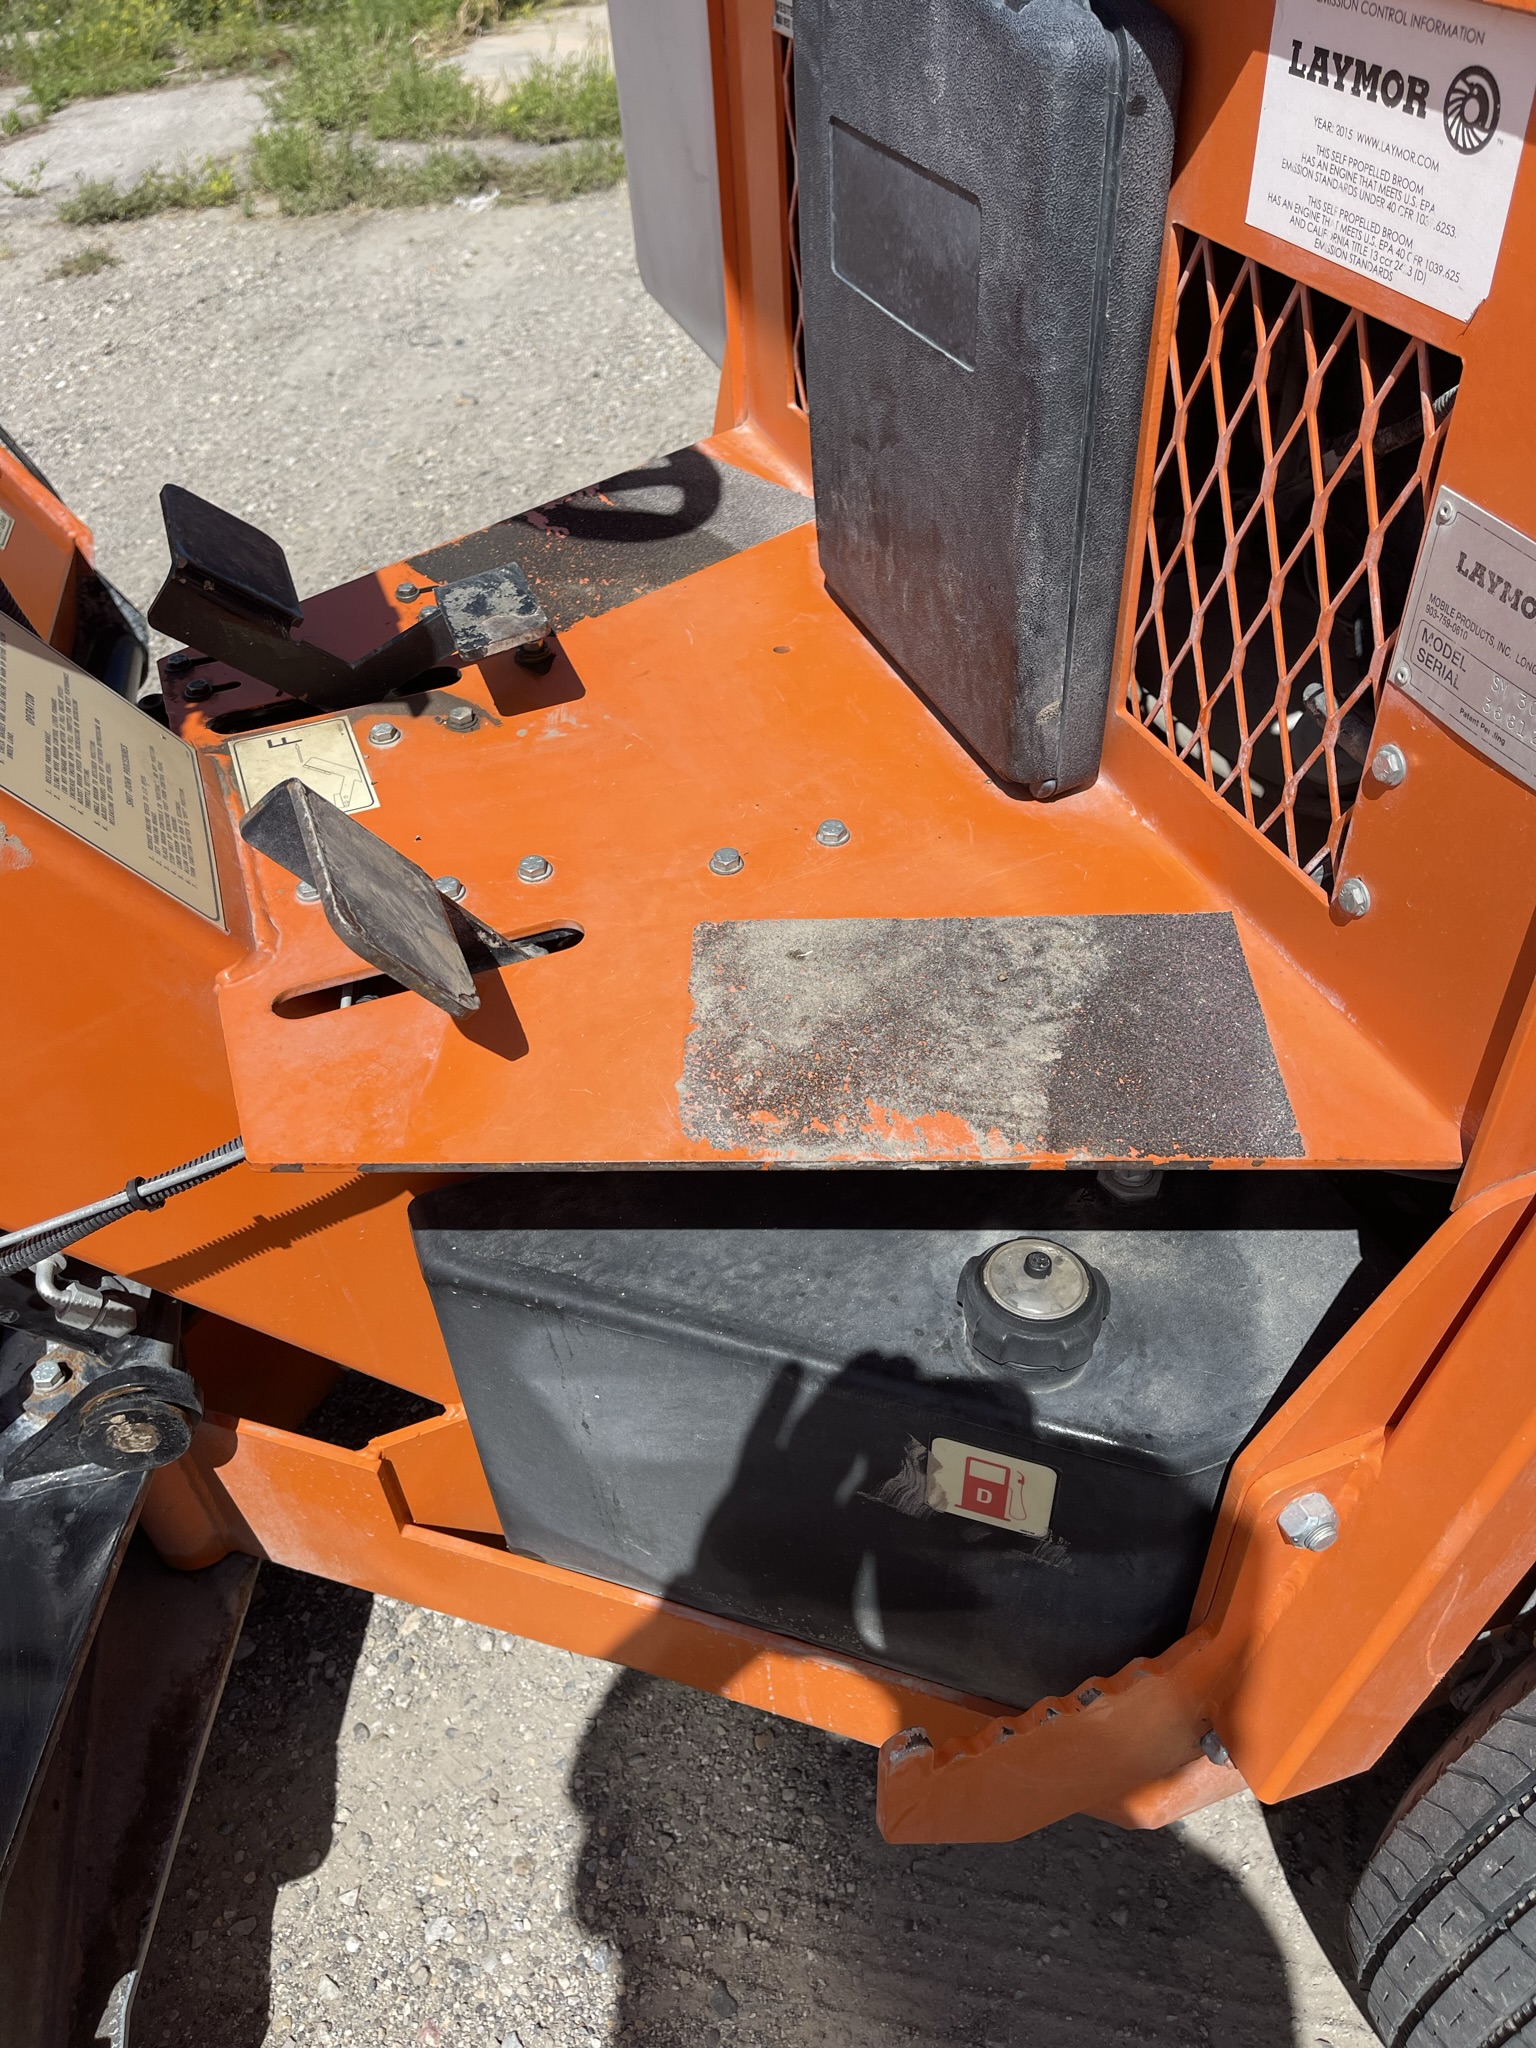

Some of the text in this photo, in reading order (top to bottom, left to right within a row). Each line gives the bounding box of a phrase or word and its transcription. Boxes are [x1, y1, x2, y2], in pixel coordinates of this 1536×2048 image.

[1316, 0, 1486, 45] SSION CONTROL INFORMATION
[1288, 40, 1430, 119] LAYMOR
[1314, 117, 1439, 171] YEAR: 2015 WWW.LAYMOR.COM
[1317, 144, 1423, 195] THIS SELF PROPELLED BROOM
[1301, 153, 1435, 213] HAS AN ENGINE THAT MEETS U.S. EPA
[1315, 172, 1357, 197] STANDARDS
[1359, 190, 1385, 208] UNDER
[1387, 202, 1396, 213] 40
[1398, 205, 1414, 220] CFR
[1416, 212, 1456, 238] 103.6253.
[1268, 192, 1281, 206] HAS
[1282, 199, 1293, 210] AN
[1294, 203, 1320, 223] ENGINE
[1322, 214, 1339, 230] THT
[1340, 224, 1362, 240] MEETS
[1364, 233, 1376, 247] U.S.
[1379, 239, 1393, 254] EPA
[1396, 248, 1405, 259] 40
[1426, 260, 1460, 283] 1039.625
[1309, 195, 1413, 248] THIS SELF PROPELLED BROOM
[1289, 216, 1306, 229] AND
[1307, 222, 1349, 248] CALIFRNIA
[1352, 241, 1368, 257] TITLE
[1370, 249, 1378, 261] 13
[1414, 269, 1426, 285] (D)
[1314, 238, 1393, 281] EMSSION STANDARDS
[1456, 550, 1536, 620] LAYMO
[1426, 604, 1468, 640] 903-759-0610
[1429, 593, 1455, 618] MOBILE
[1456, 612, 1494, 648] PRODUCTS,
[1497, 641, 1511, 658] INC.
[1417, 648, 1458, 690] SERIAL
[1422, 628, 1465, 672] MODEL
[25, 692, 35, 725] OPERATION
[267, 736, 303, 749] F
[976, 1487, 993, 1504] D
